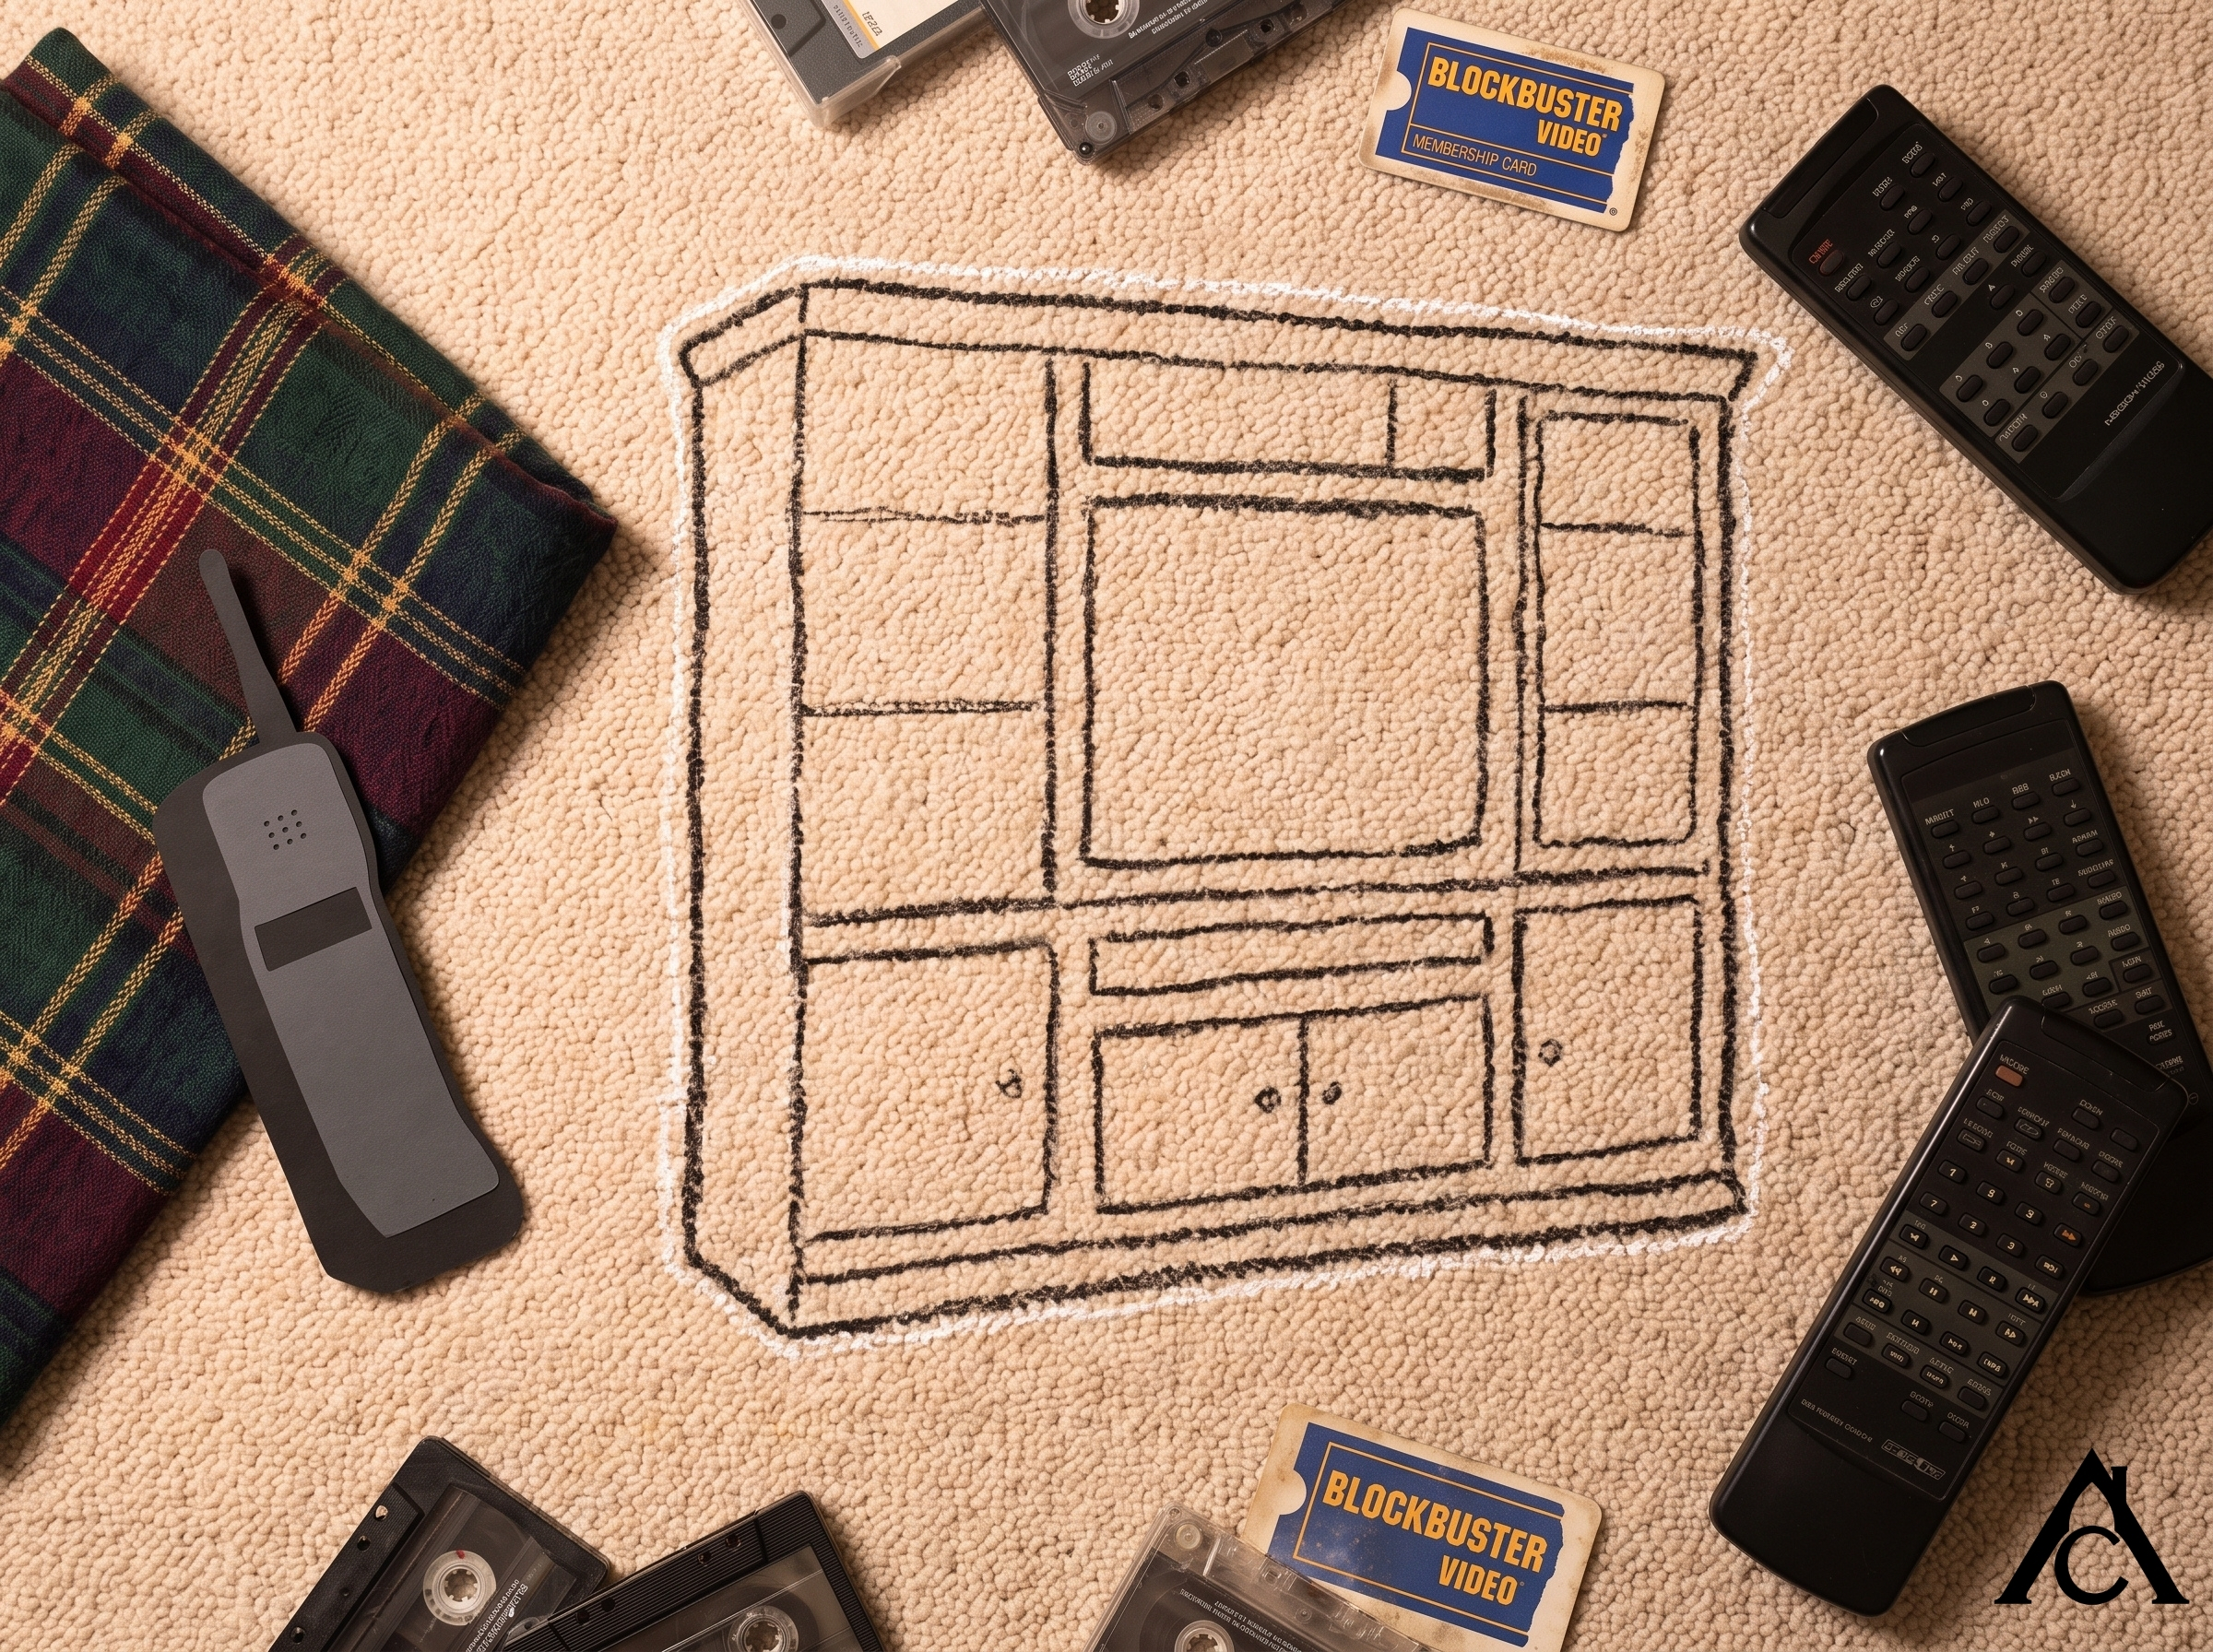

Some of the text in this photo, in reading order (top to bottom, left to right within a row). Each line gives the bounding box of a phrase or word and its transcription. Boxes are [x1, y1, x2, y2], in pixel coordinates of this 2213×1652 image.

[1427, 56, 1623, 132] BLOCKBUSTER
[1413, 134, 1538, 177] MEMBERSHIP CARD
[1537, 119, 1603, 157] VIDEO
[1322, 1469, 1548, 1573] BLOCKBUSTER
[1438, 1554, 1520, 1606] VIDEO
